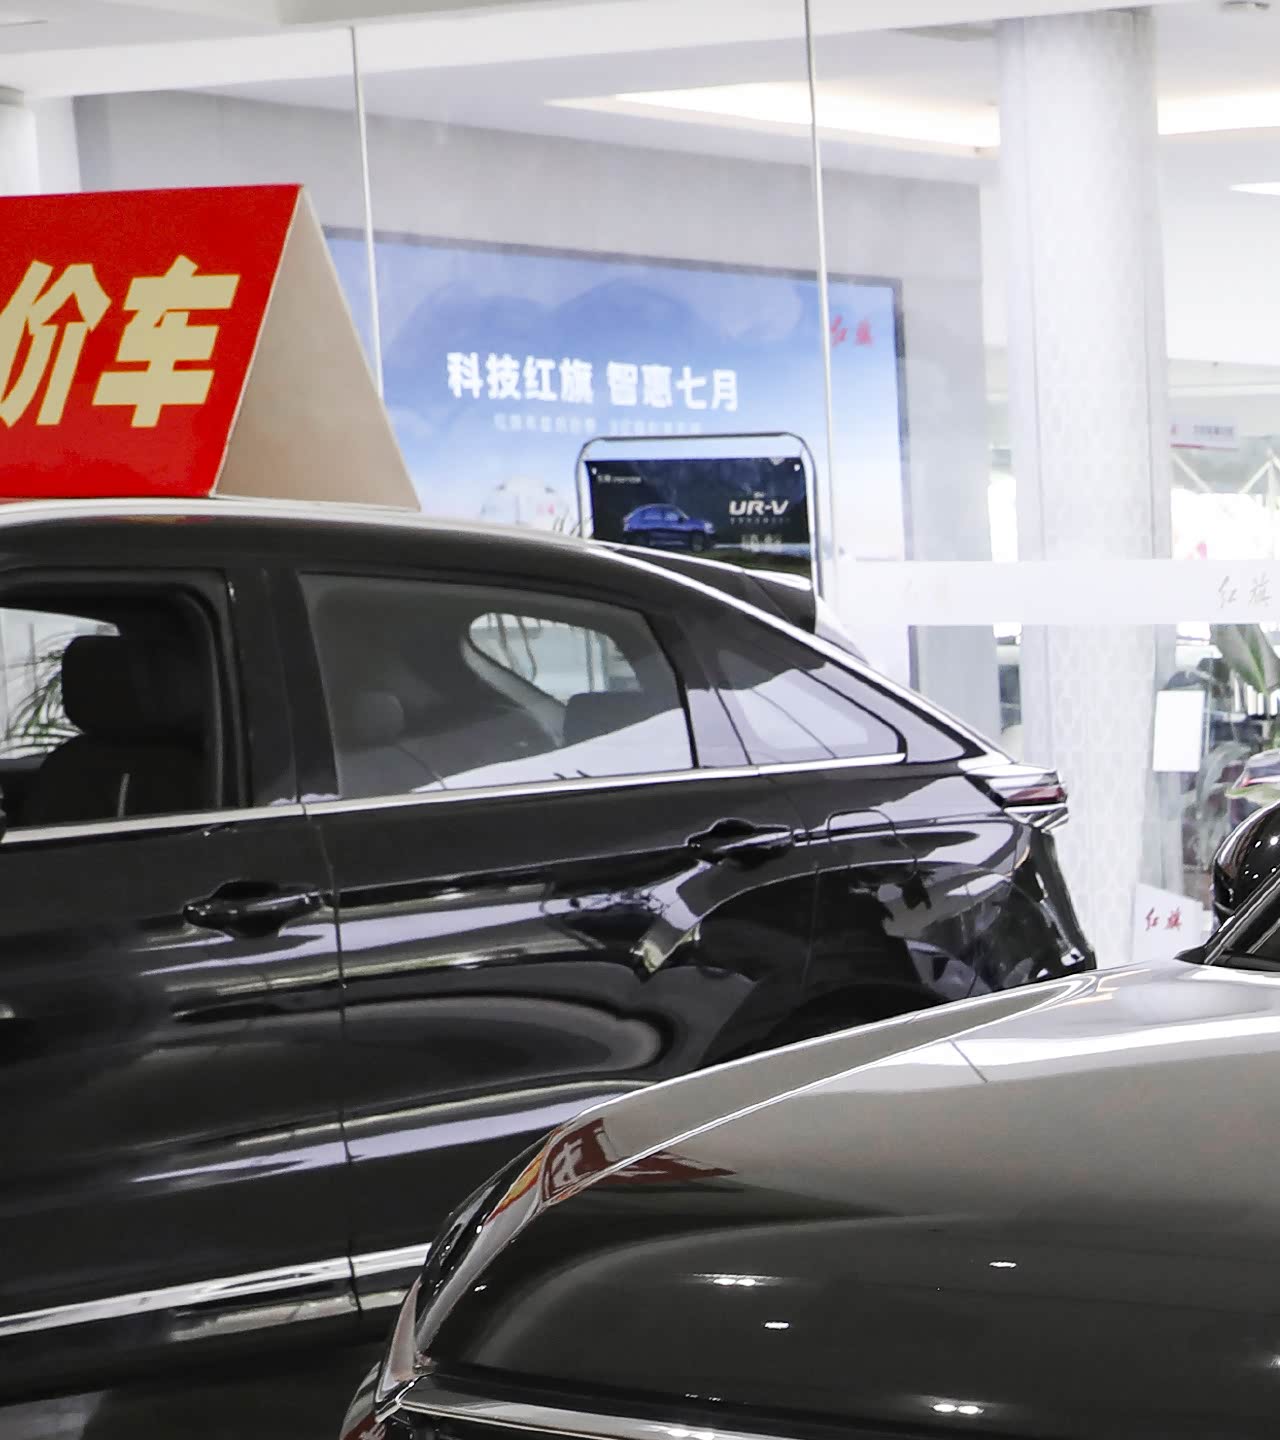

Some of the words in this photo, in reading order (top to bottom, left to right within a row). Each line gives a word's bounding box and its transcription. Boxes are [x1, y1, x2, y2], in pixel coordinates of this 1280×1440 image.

[0, 254, 241, 428] 价车
[446, 351, 594, 404] 科技红旗
[728, 499, 789, 516] UR-V
[1217, 571, 1273, 608] 红旗
